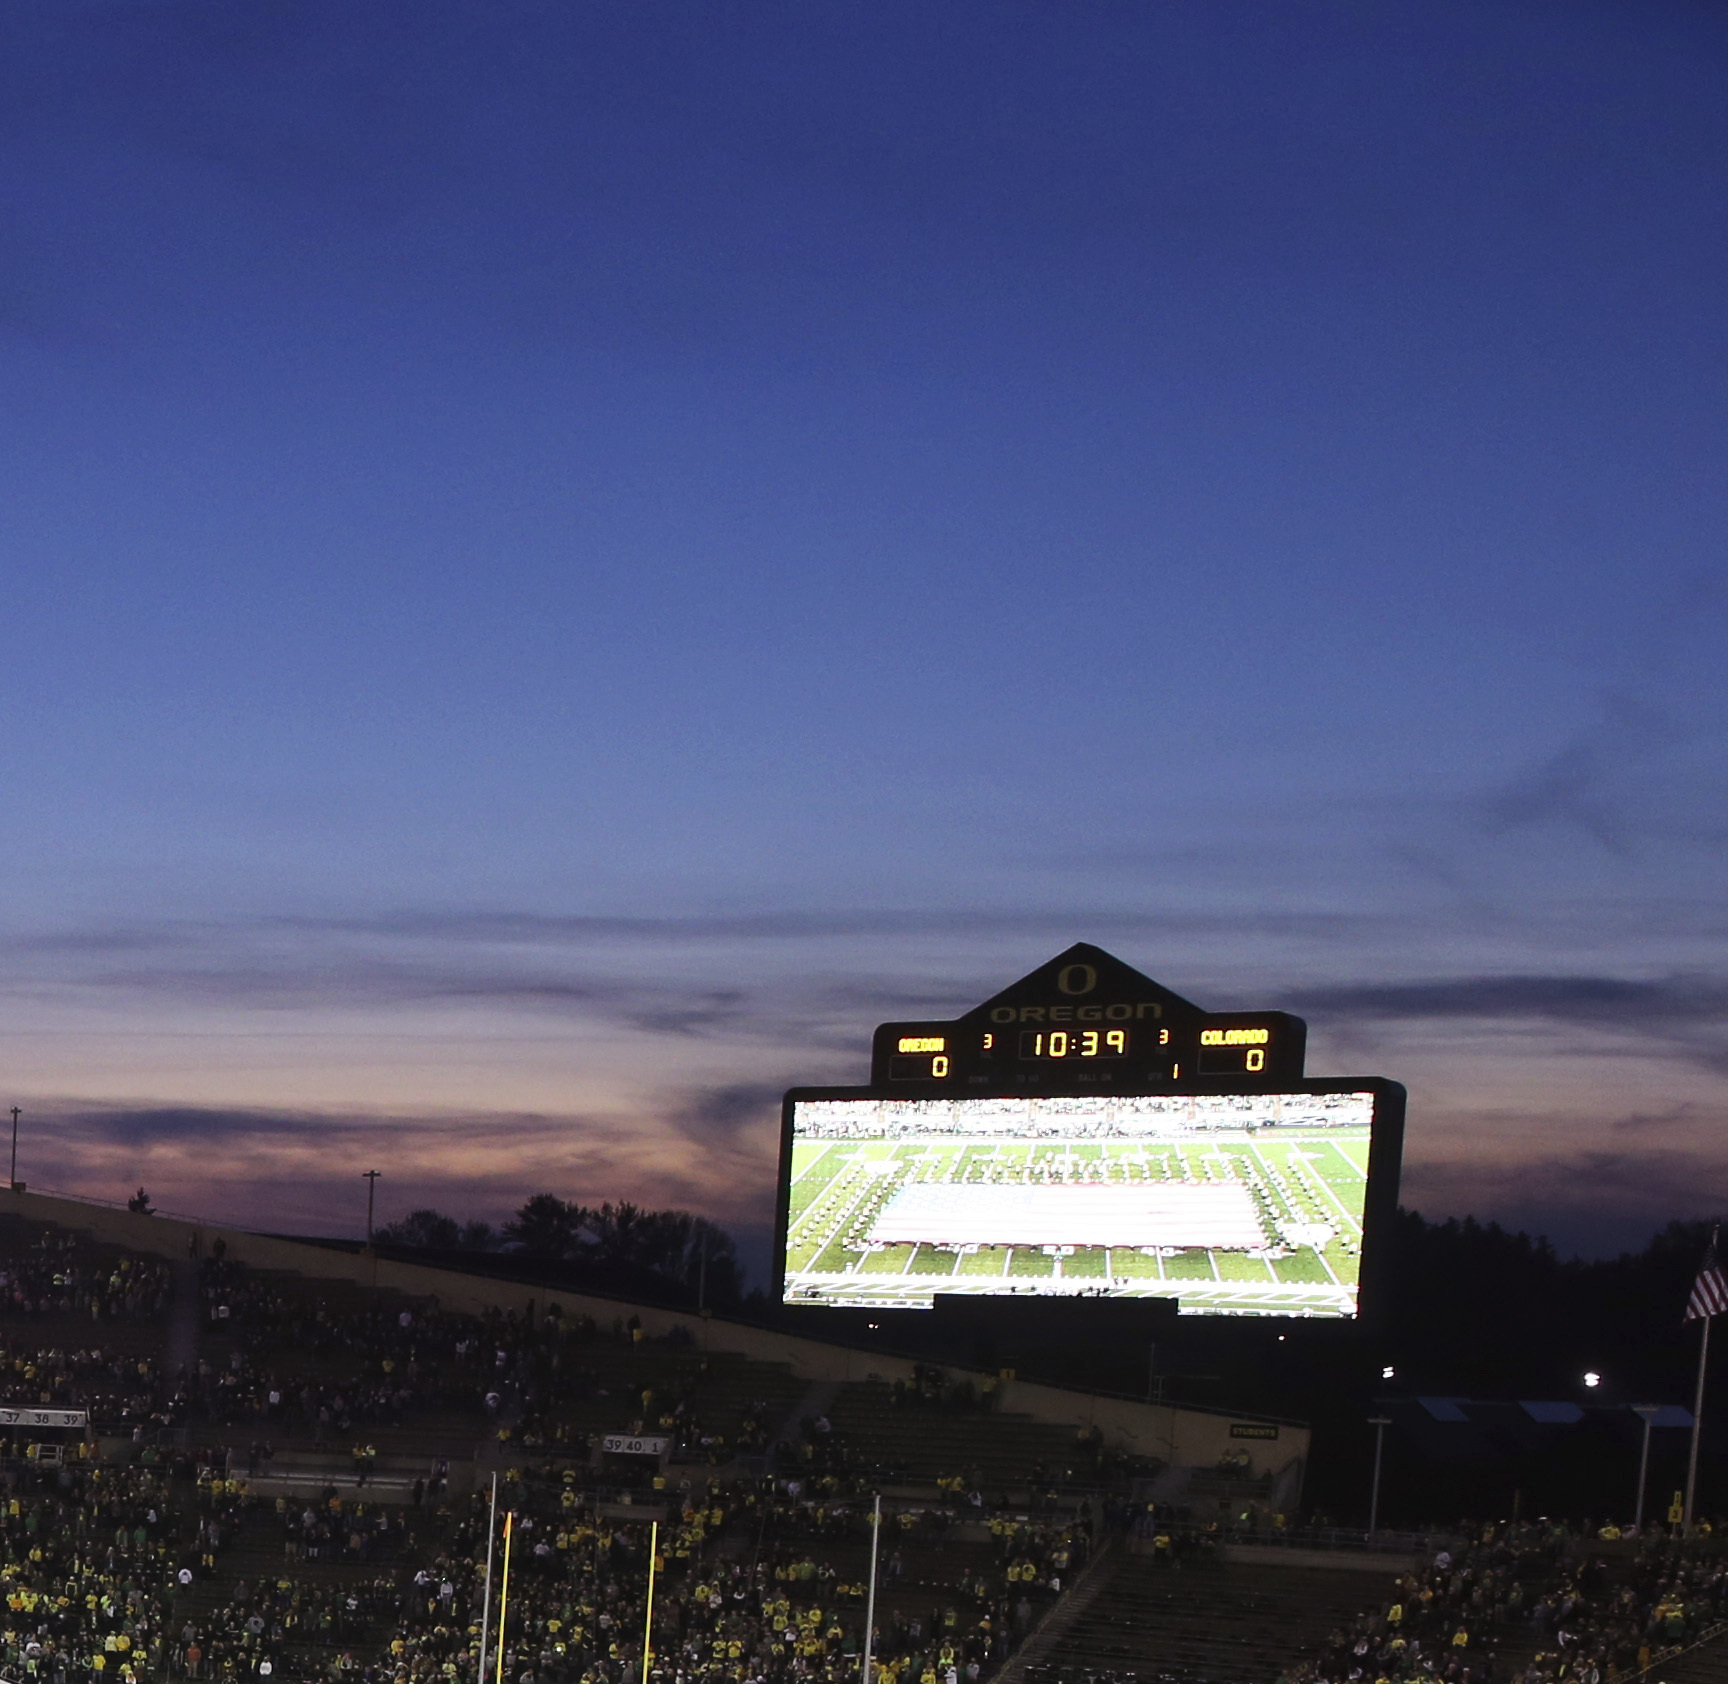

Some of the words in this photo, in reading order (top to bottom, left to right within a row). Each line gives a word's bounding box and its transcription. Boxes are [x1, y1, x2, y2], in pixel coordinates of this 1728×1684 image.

[983, 1033, 993, 1049] 3
[1035, 1030, 1124, 1058] 10:39
[1159, 1029, 1169, 1045] 3
[1200, 1029, 1269, 1045] COLORADO
[898, 1038, 944, 1053] OREGON
[932, 1056, 948, 1077] 0
[1246, 1049, 1264, 1071] 0
[1173, 1063, 1179, 1079] 1
[6, 1413, 19, 1423] 37
[35, 1413, 48, 1424] 38
[63, 1414, 77, 1425] 39
[1232, 1427, 1276, 1438] STUDENTS
[607, 1439, 622, 1450] 39
[626, 1440, 641, 1451] 40
[653, 1442, 658, 1453] 1
